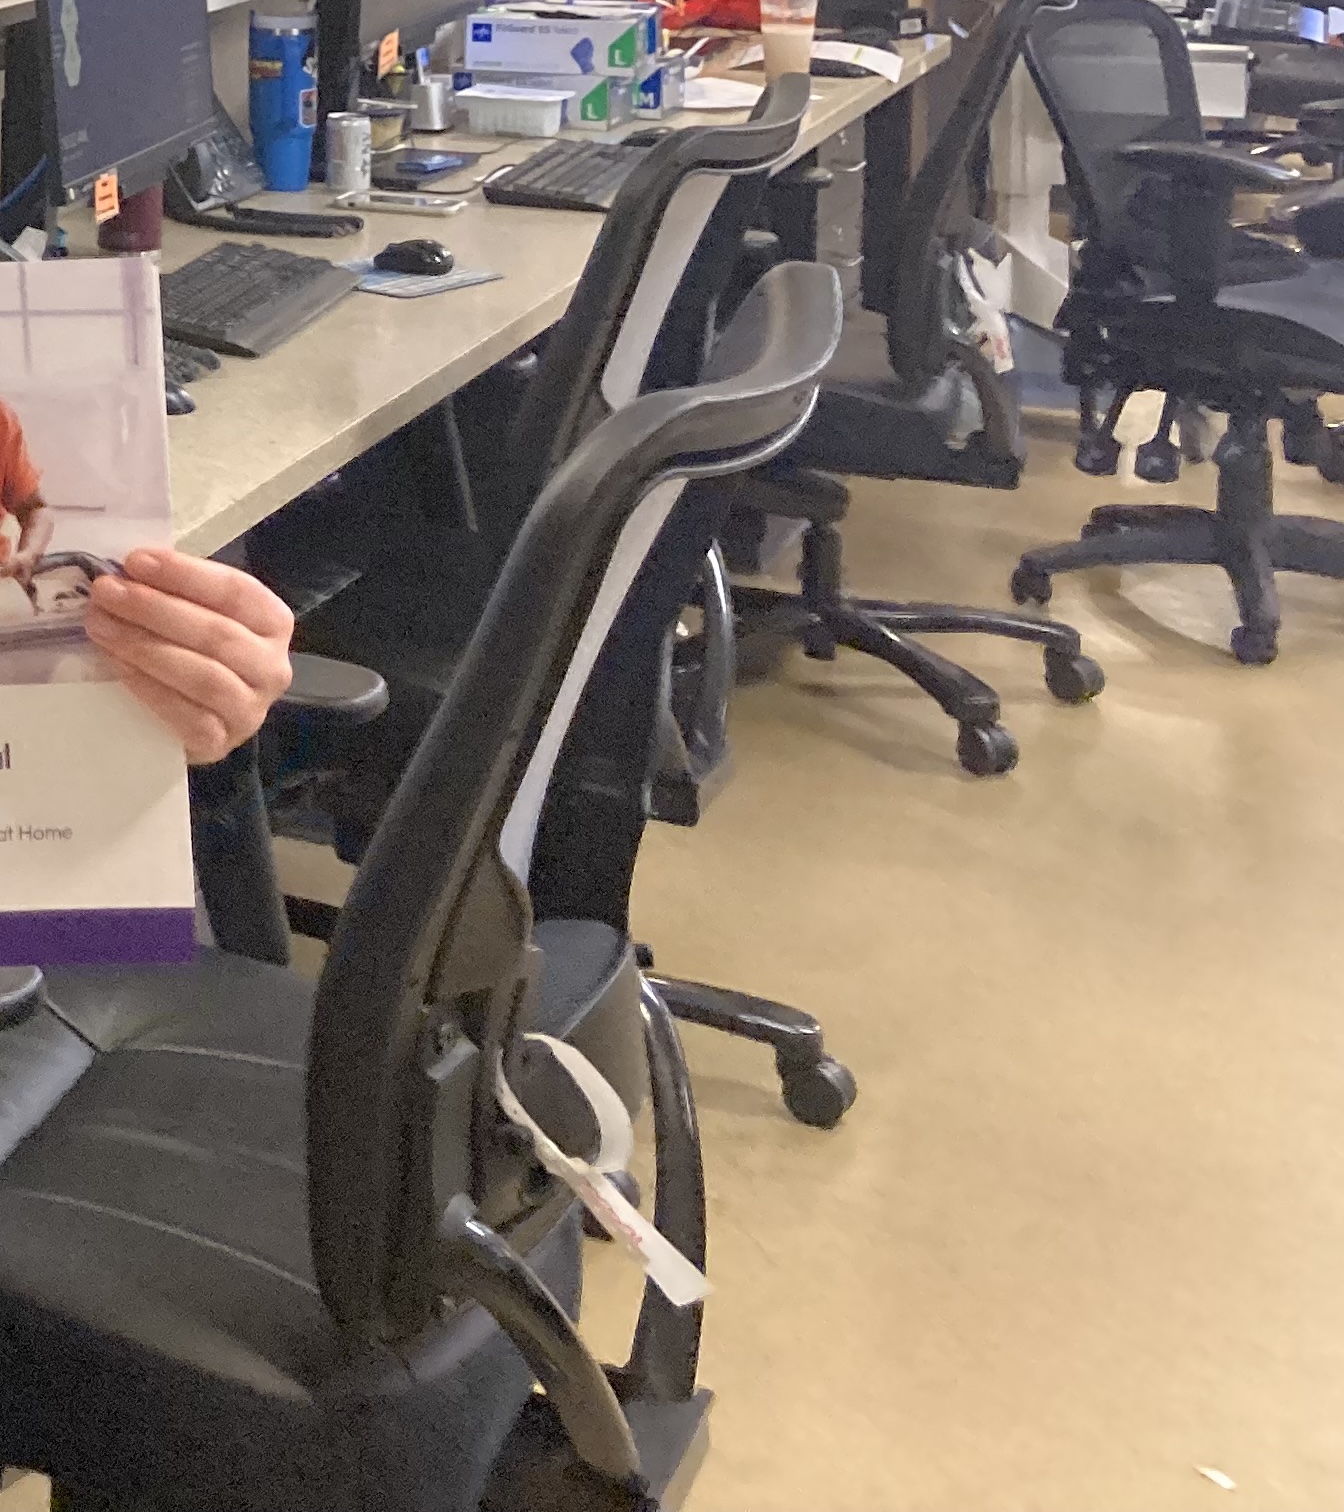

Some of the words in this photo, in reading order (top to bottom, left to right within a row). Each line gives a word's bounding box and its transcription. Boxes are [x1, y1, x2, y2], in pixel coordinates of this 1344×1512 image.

[614, 50, 626, 65] L
[640, 93, 654, 107] M
[587, 103, 598, 119] L
[19, 825, 73, 842] Home
